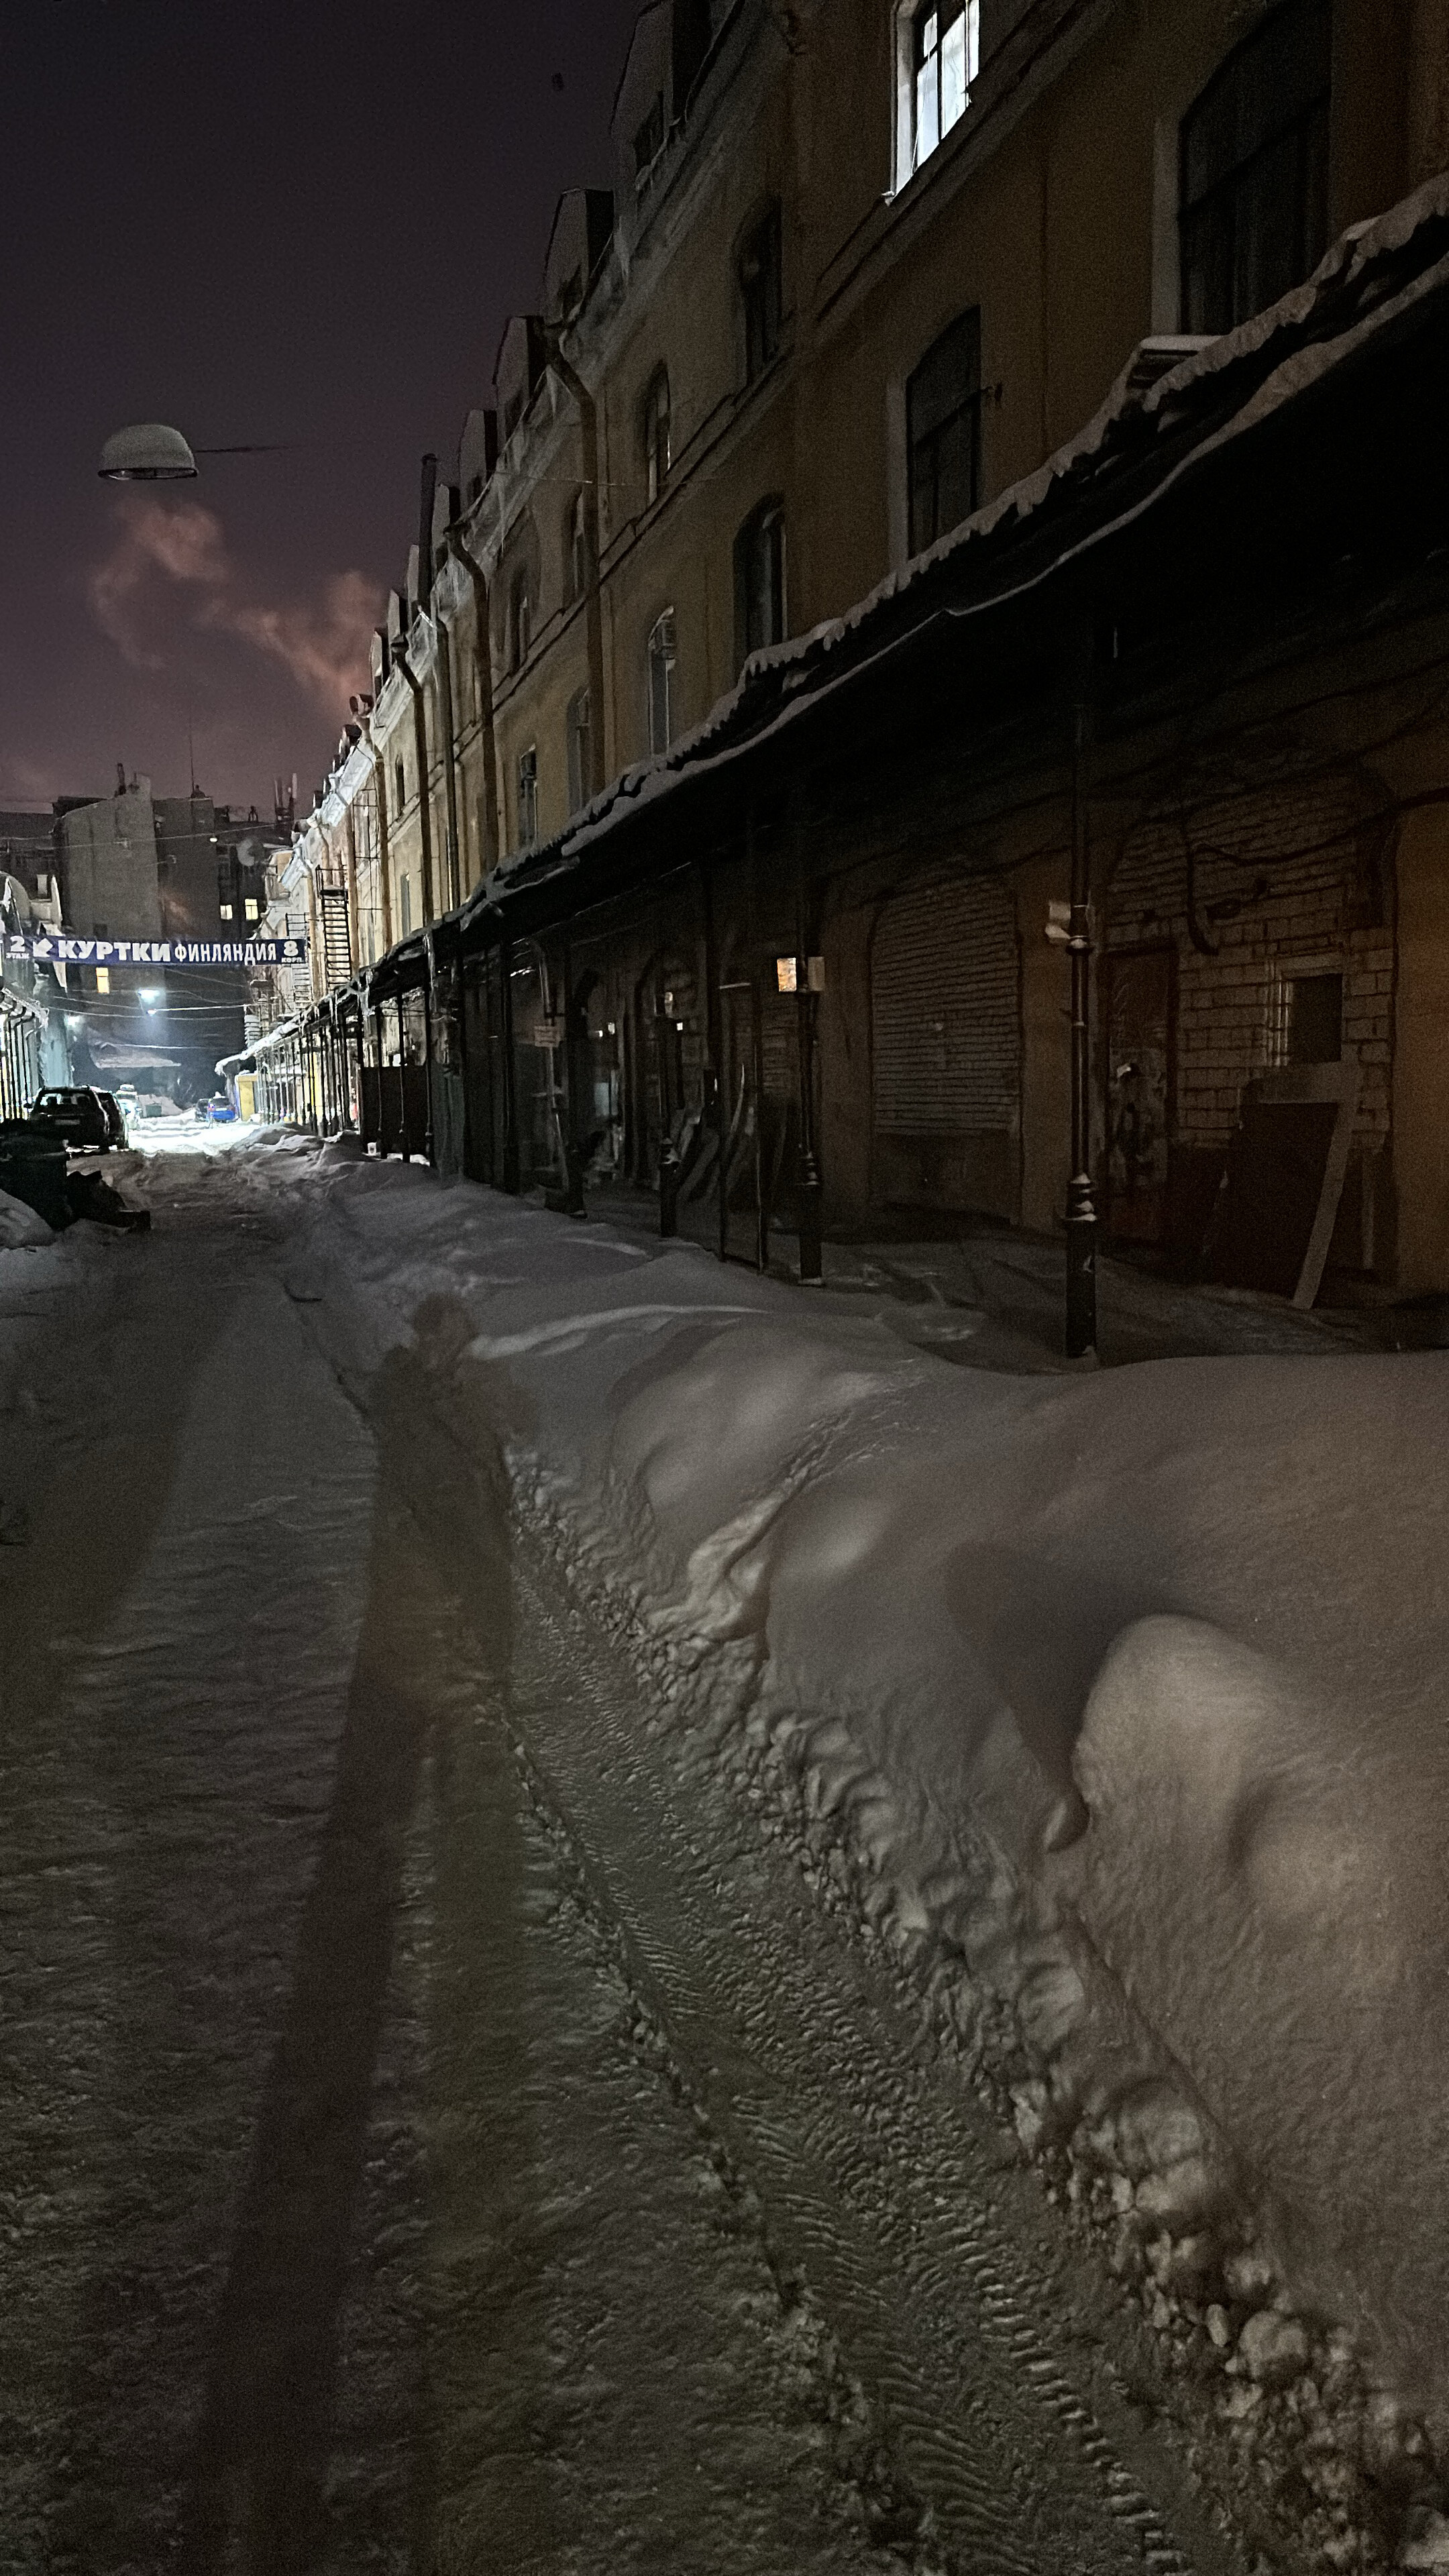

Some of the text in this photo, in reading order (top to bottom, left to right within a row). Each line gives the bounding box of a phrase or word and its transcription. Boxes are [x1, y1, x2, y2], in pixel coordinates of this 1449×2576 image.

[10, 935, 25, 951] 2
[284, 941, 299, 956] 8
[58, 940, 276, 966] КУРТКИ ФИНЛЯНДИЯ
